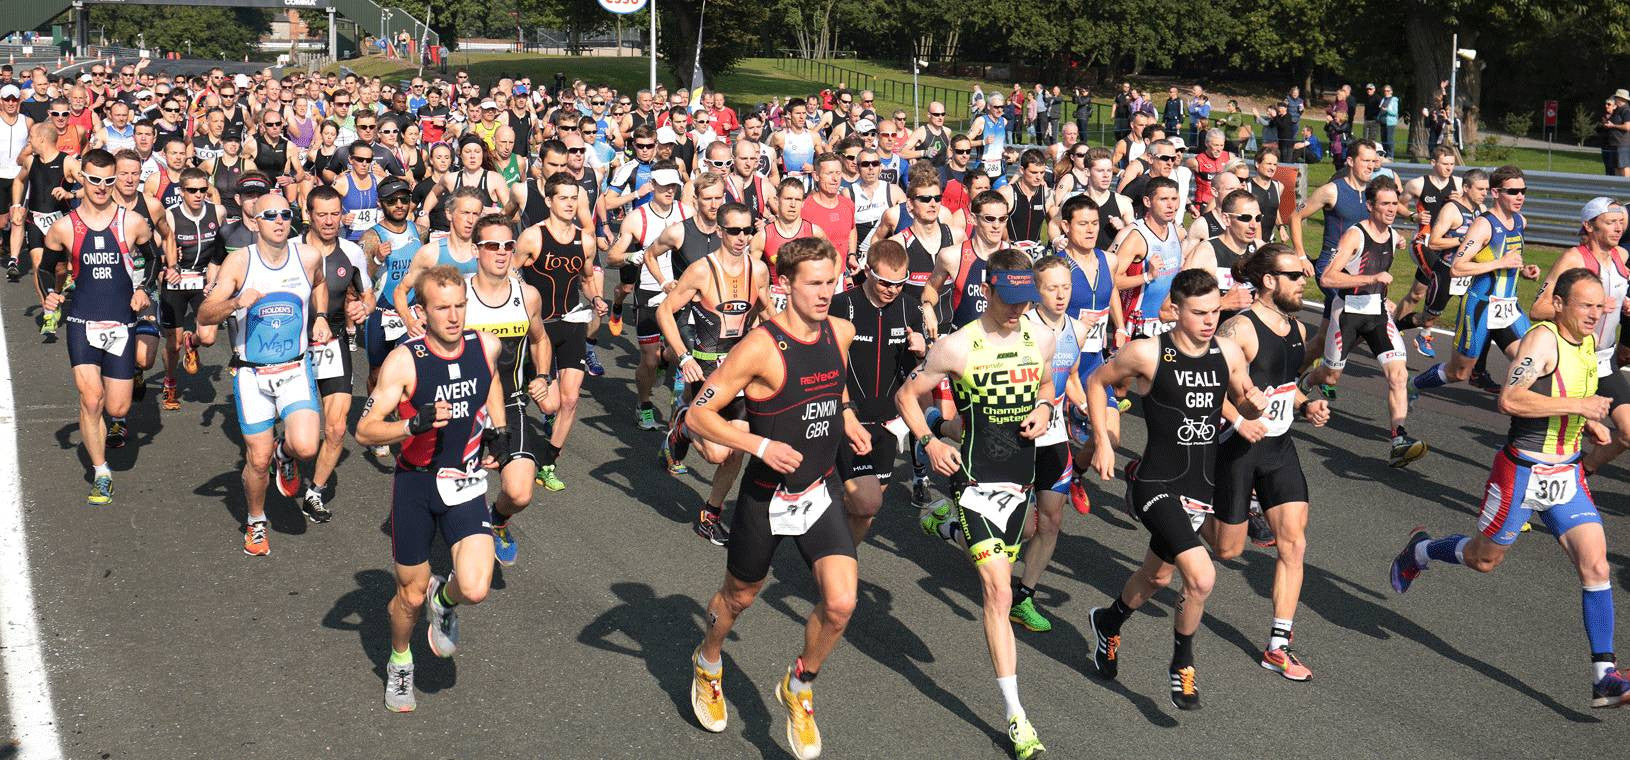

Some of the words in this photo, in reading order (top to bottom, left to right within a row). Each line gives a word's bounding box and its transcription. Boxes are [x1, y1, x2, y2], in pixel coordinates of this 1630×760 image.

[358, 210, 371, 223] 48
[83, 252, 119, 265] ONDREJ
[92, 267, 112, 279] GBR
[724, 302, 747, 311] DTC
[100, 331, 117, 347] 95
[973, 368, 1040, 387] VCUK
[1174, 370, 1220, 387] VEALL
[435, 378, 478, 402] AVERY
[1185, 392, 1214, 408] GBR
[450, 401, 470, 419] BR
[801, 400, 838, 421] JENKIN
[805, 421, 830, 440] GBR
[1535, 479, 1568, 502] 301
